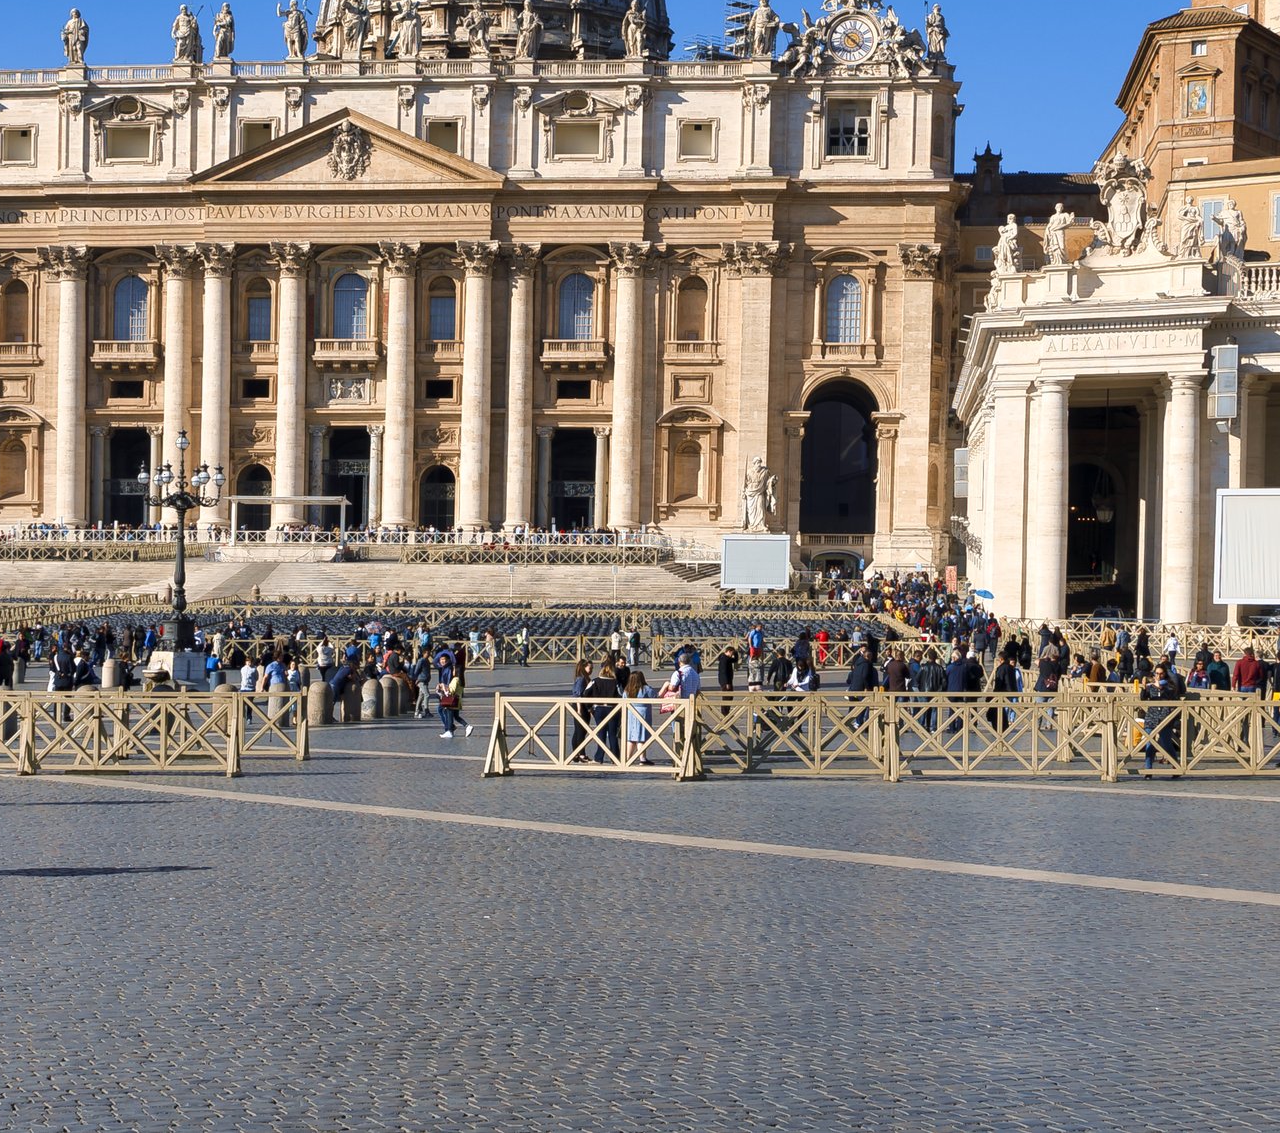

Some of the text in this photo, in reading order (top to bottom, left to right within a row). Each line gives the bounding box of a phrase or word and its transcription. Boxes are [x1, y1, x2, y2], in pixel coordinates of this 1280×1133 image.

[60, 208, 148, 223] PRINCIPIS
[207, 205, 265, 219] PAVLVS
[284, 204, 393, 219] BVRGHESIVS
[398, 204, 490, 219] ROMANVS
[1046, 336, 1120, 352] ALEXAN
